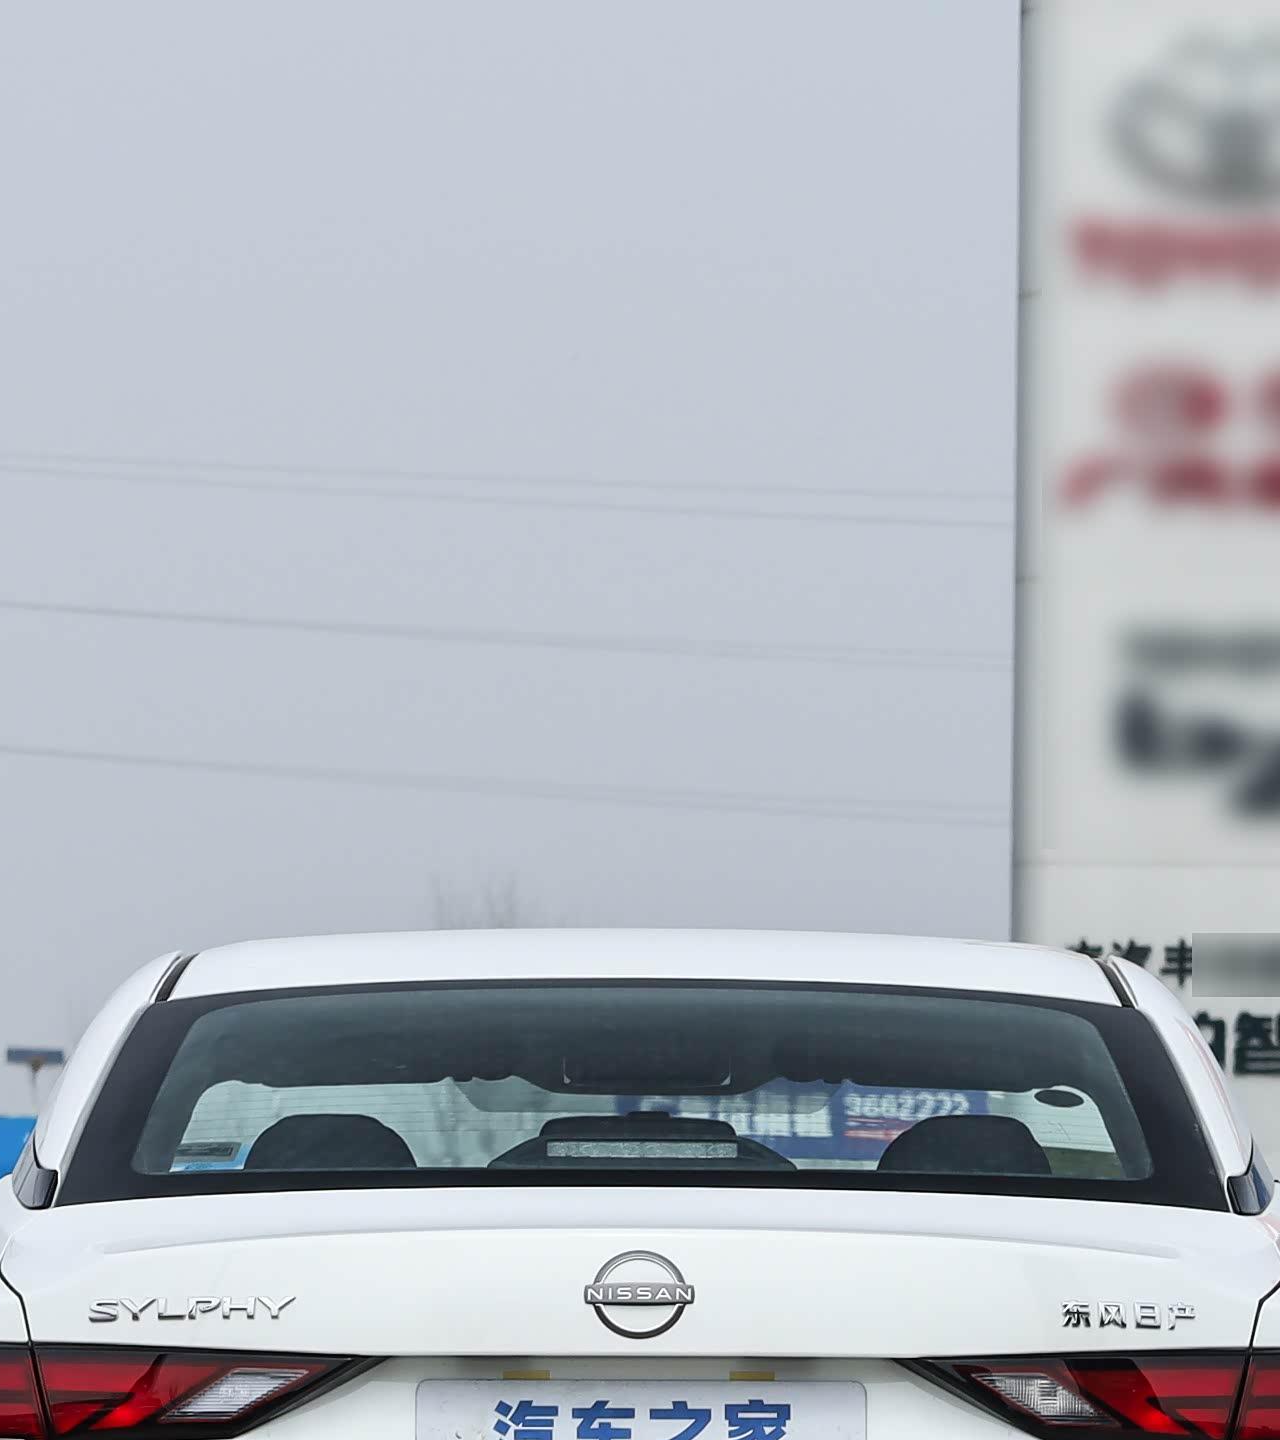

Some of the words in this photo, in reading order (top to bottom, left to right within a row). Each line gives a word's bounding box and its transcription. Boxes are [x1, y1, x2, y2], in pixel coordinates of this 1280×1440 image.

[587, 1287, 692, 1301] NISSAN
[88, 1296, 297, 1323] SYLPHY
[1061, 1300, 1196, 1331] 东风日产
